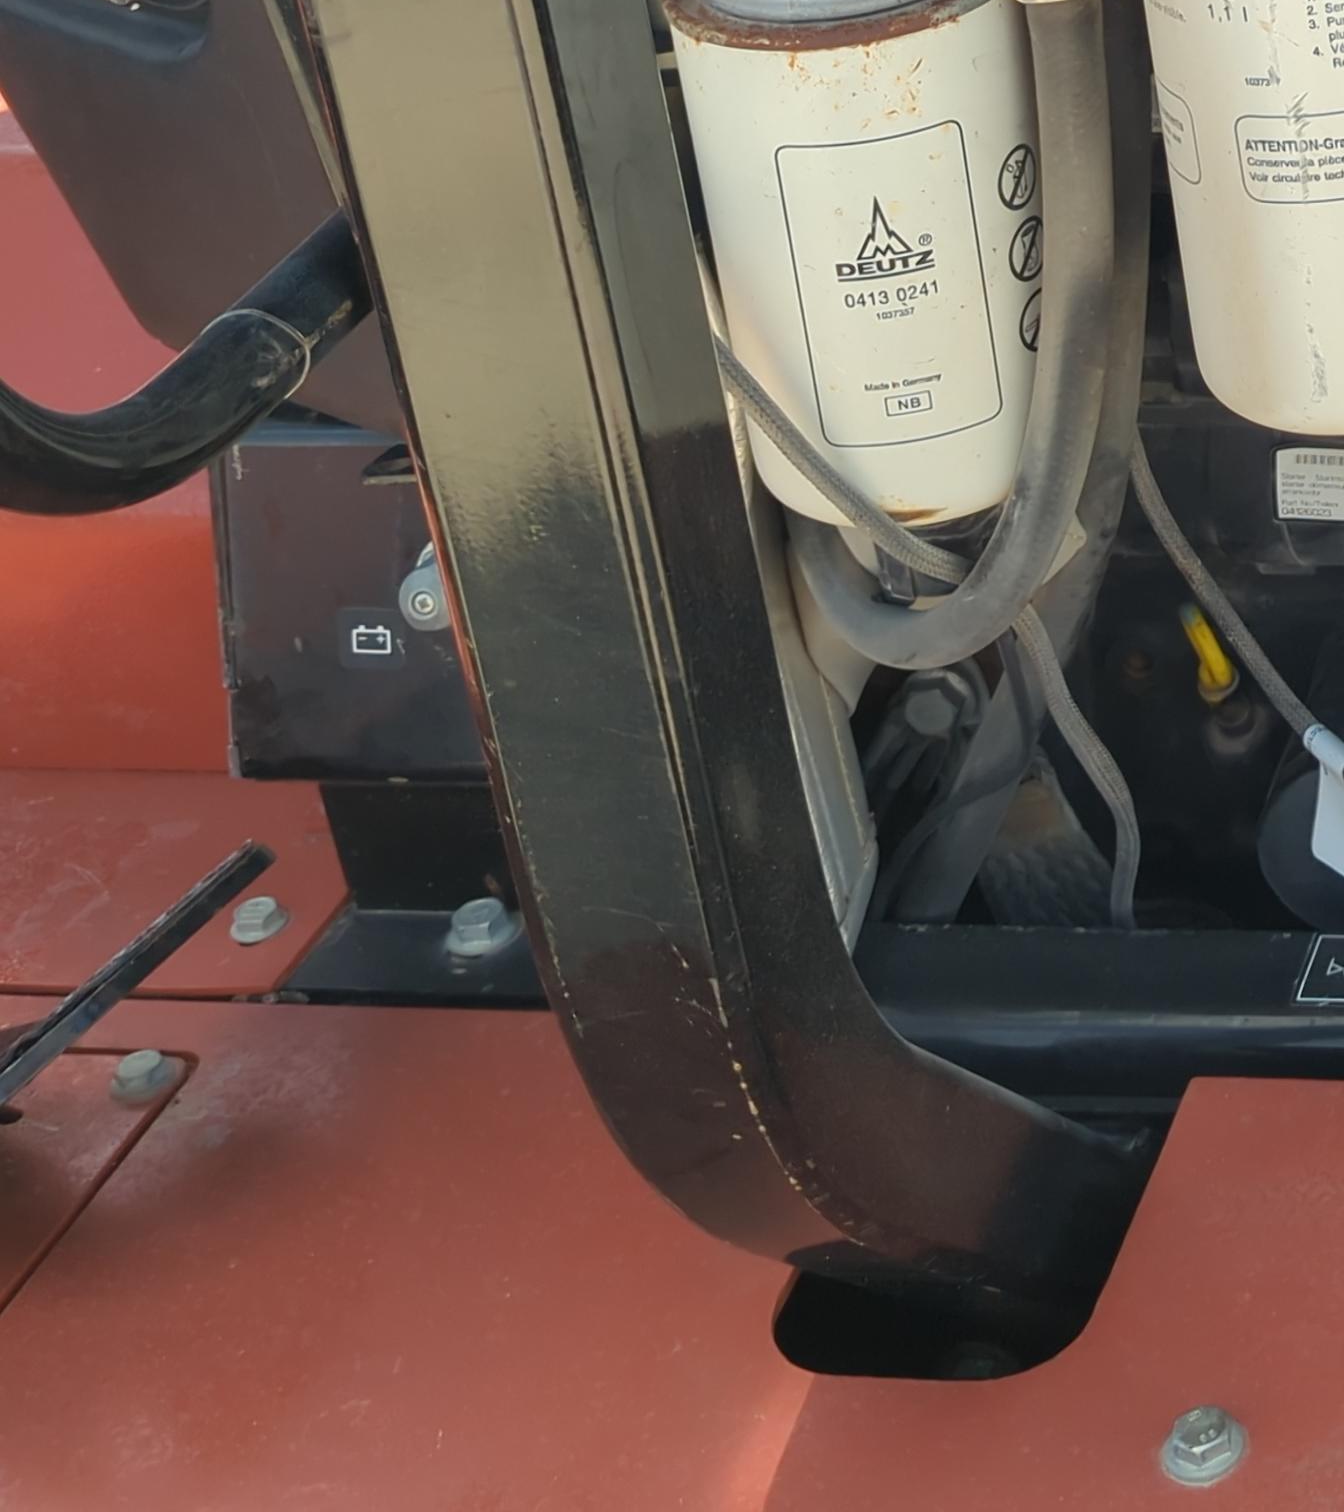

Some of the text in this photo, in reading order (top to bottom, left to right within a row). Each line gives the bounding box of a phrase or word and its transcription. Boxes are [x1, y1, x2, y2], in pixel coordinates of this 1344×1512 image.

[1306, 5, 1318, 16] 2.
[1308, 19, 1320, 30] 3.
[1312, 46, 1325, 57] 4.
[1249, 171, 1269, 184] Voir
[835, 248, 935, 278] DEUTZ
[844, 279, 940, 309] 0413 0241
[864, 382, 890, 392] Made
[902, 373, 943, 388] Germany
[896, 396, 922, 411] NB
